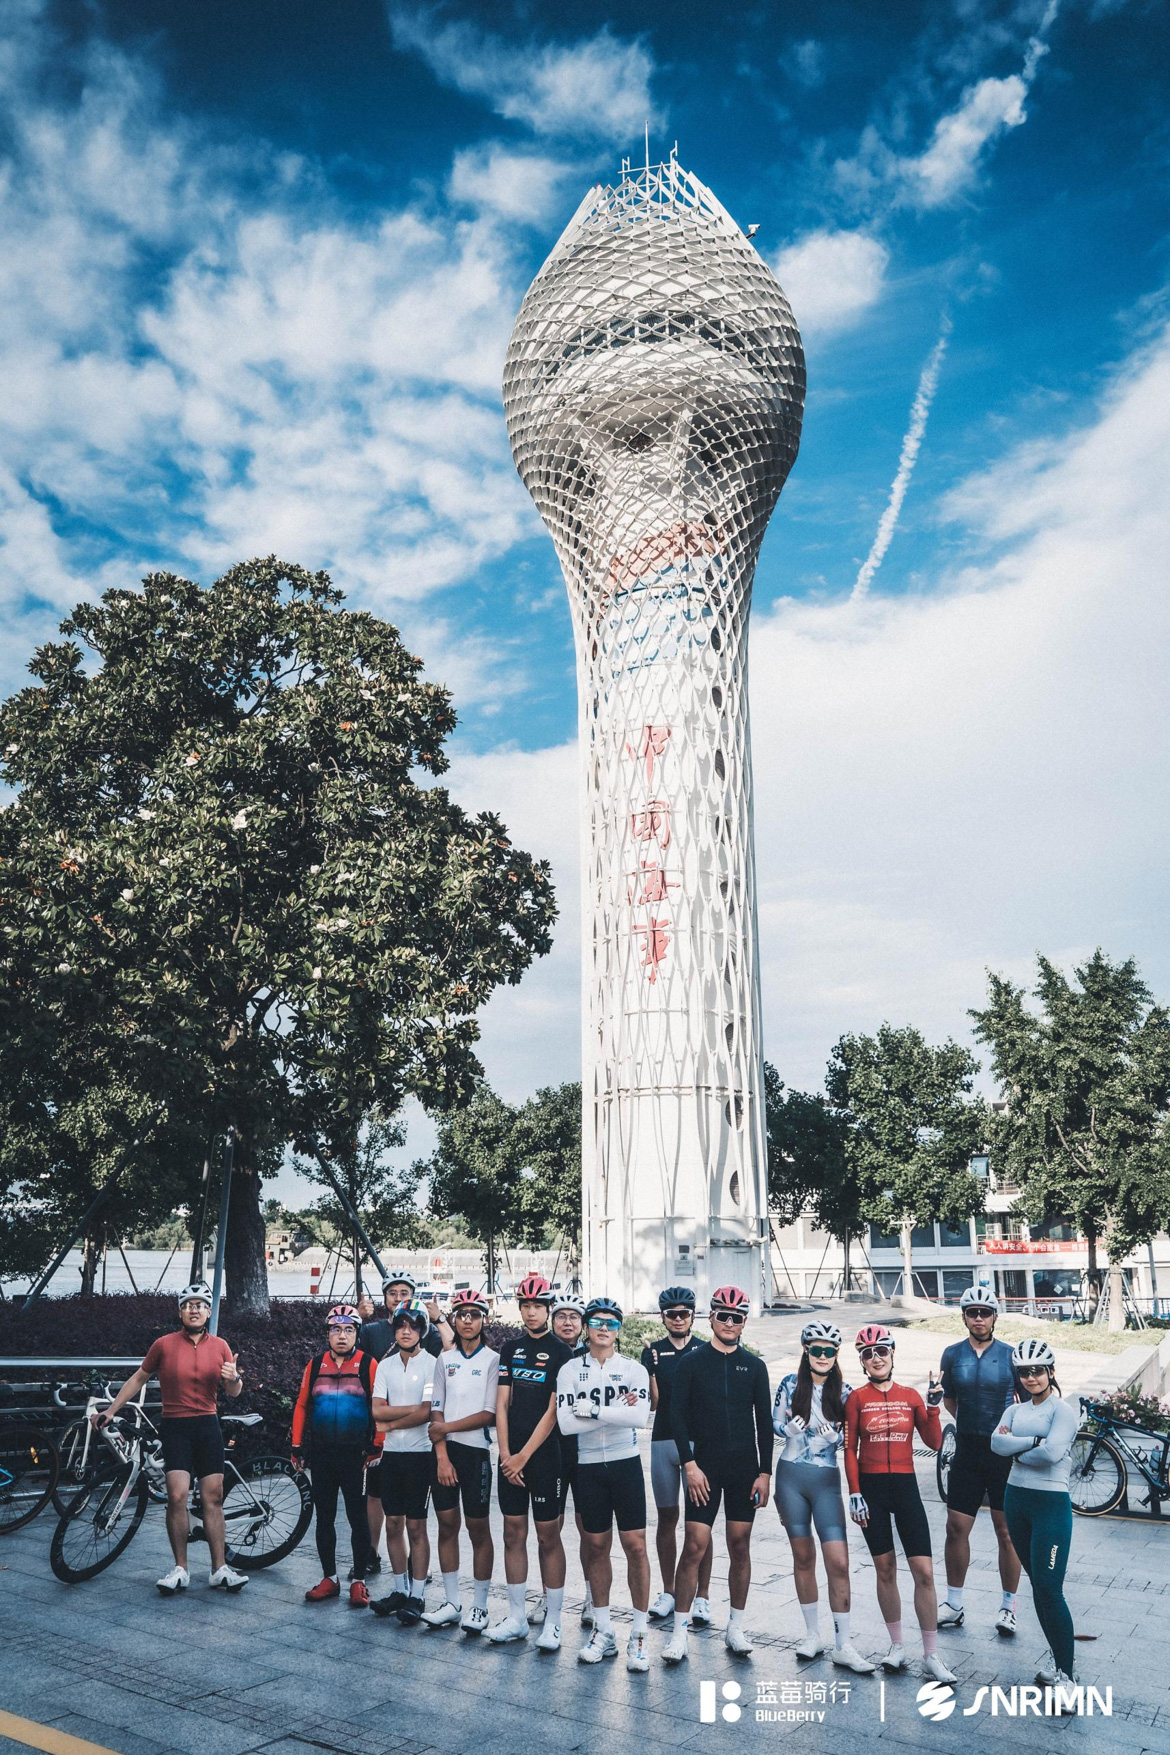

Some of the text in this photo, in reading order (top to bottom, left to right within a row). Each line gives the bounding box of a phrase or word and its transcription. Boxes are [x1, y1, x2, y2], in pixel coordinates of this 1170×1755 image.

[513, 1369, 545, 1379] MBO
[252, 1461, 312, 1511] BLACK INC
